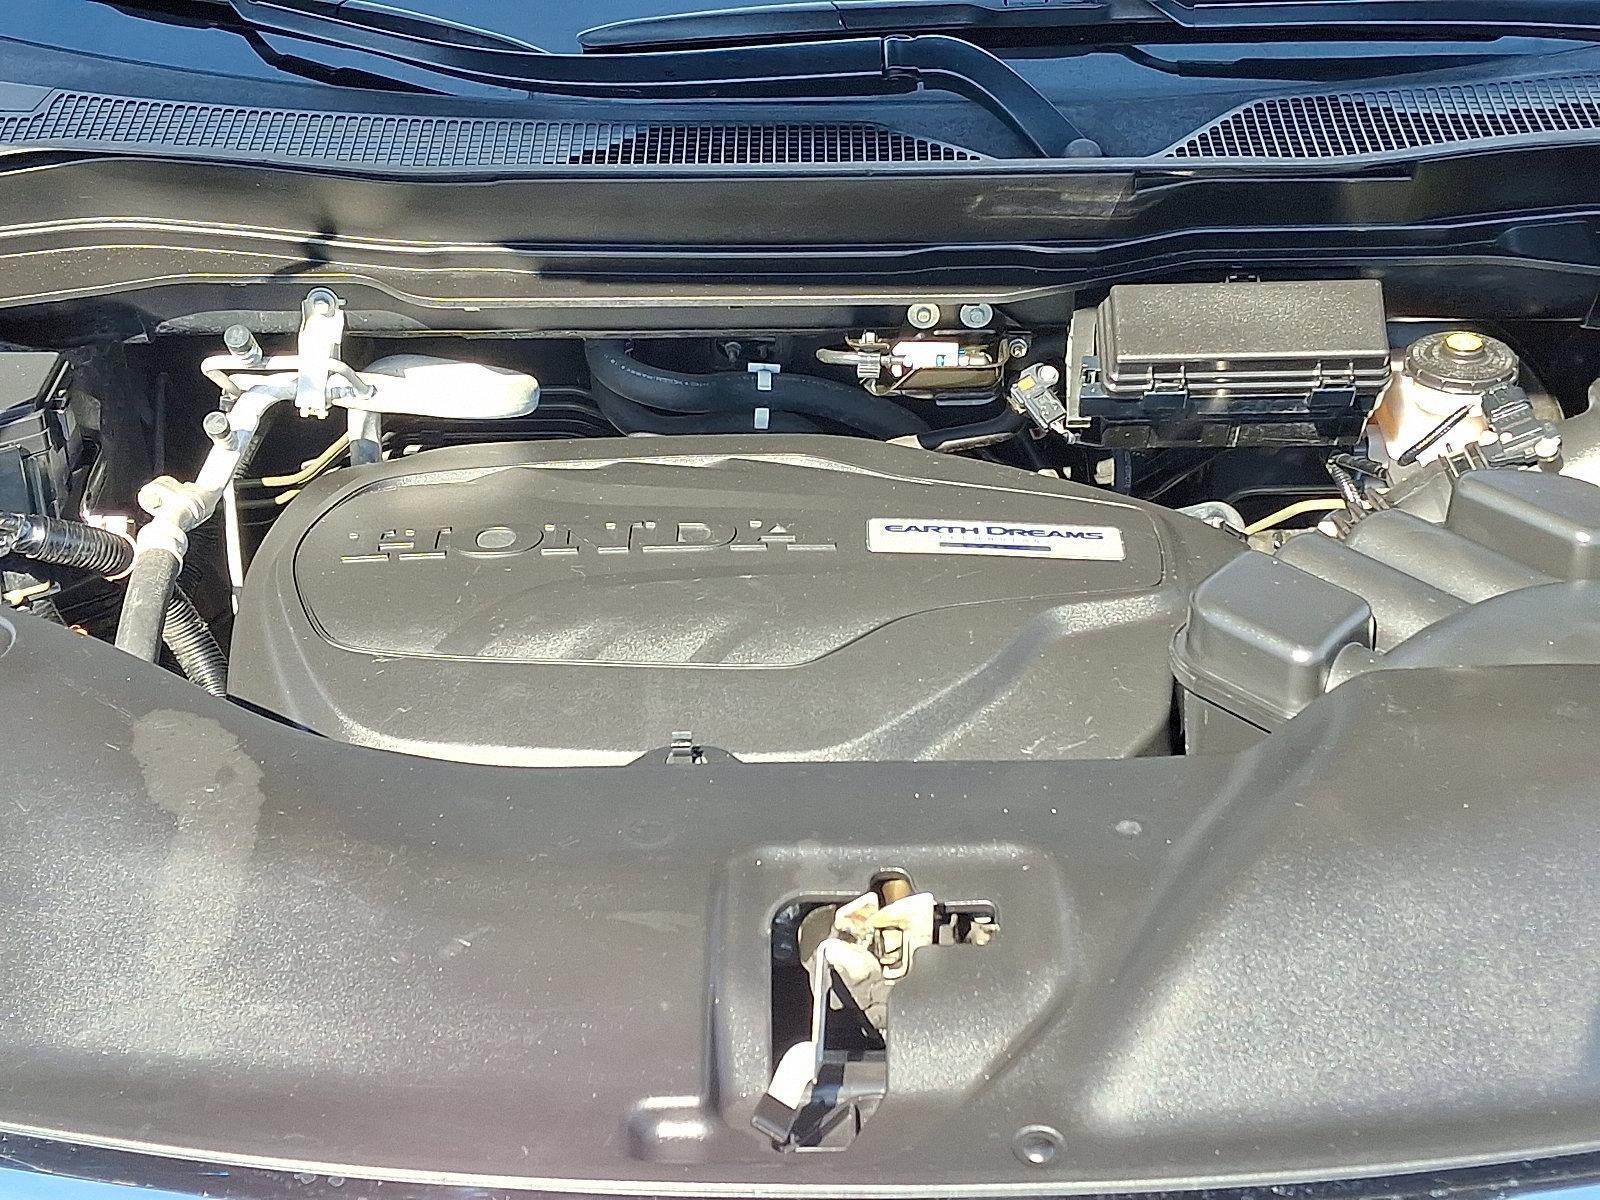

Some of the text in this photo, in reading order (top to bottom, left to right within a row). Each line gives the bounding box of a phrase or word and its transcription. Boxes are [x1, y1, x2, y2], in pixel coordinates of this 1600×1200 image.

[341, 519, 837, 563] HONDA
[884, 524, 979, 535] EARTH
[987, 526, 1104, 540] DREAMS
